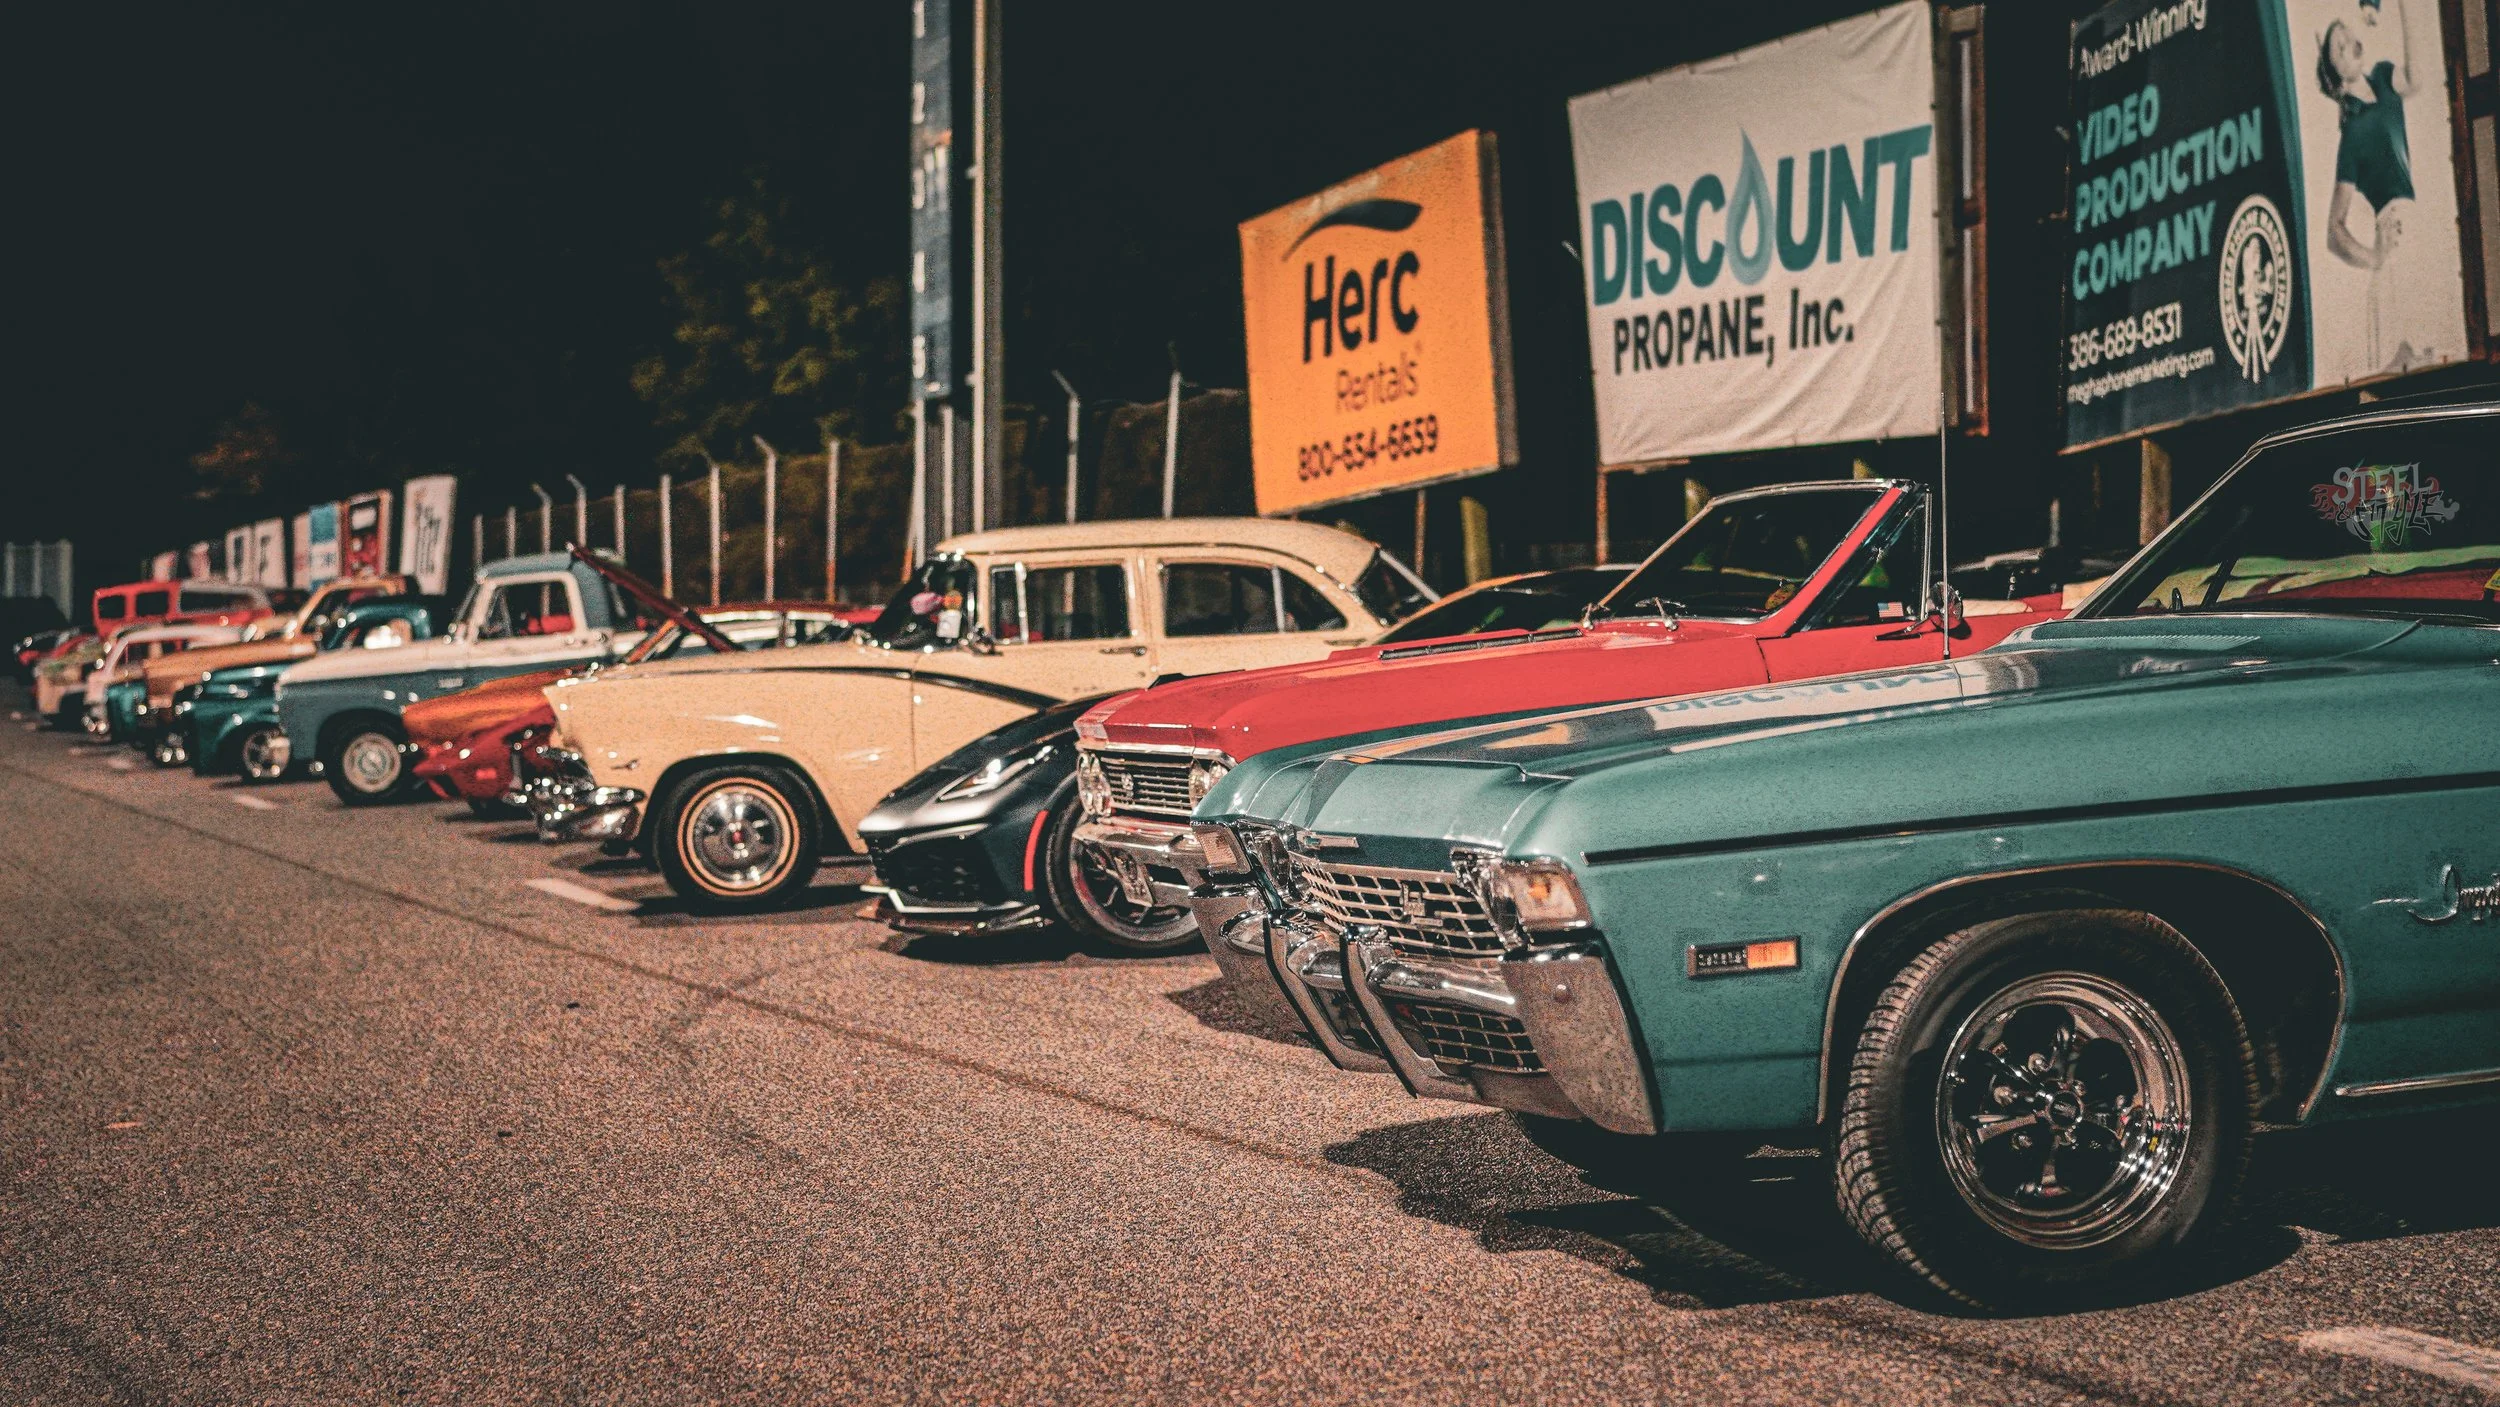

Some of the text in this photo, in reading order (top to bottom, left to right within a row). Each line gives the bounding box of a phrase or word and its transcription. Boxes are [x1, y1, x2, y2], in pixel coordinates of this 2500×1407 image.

[2078, 0, 2207, 80] Award-Winning
[2078, 84, 2160, 165] VIDEO
[2074, 107, 2263, 233] PRODUCTION
[1591, 122, 1933, 307] DISCOUNT
[2073, 201, 2216, 301] COMPANY
[1302, 250, 1420, 364] Herc
[1614, 288, 1854, 376] PROPANE, Inc.
[2068, 302, 2183, 371] 386-689-8531
[1335, 351, 1420, 415] Rentals
